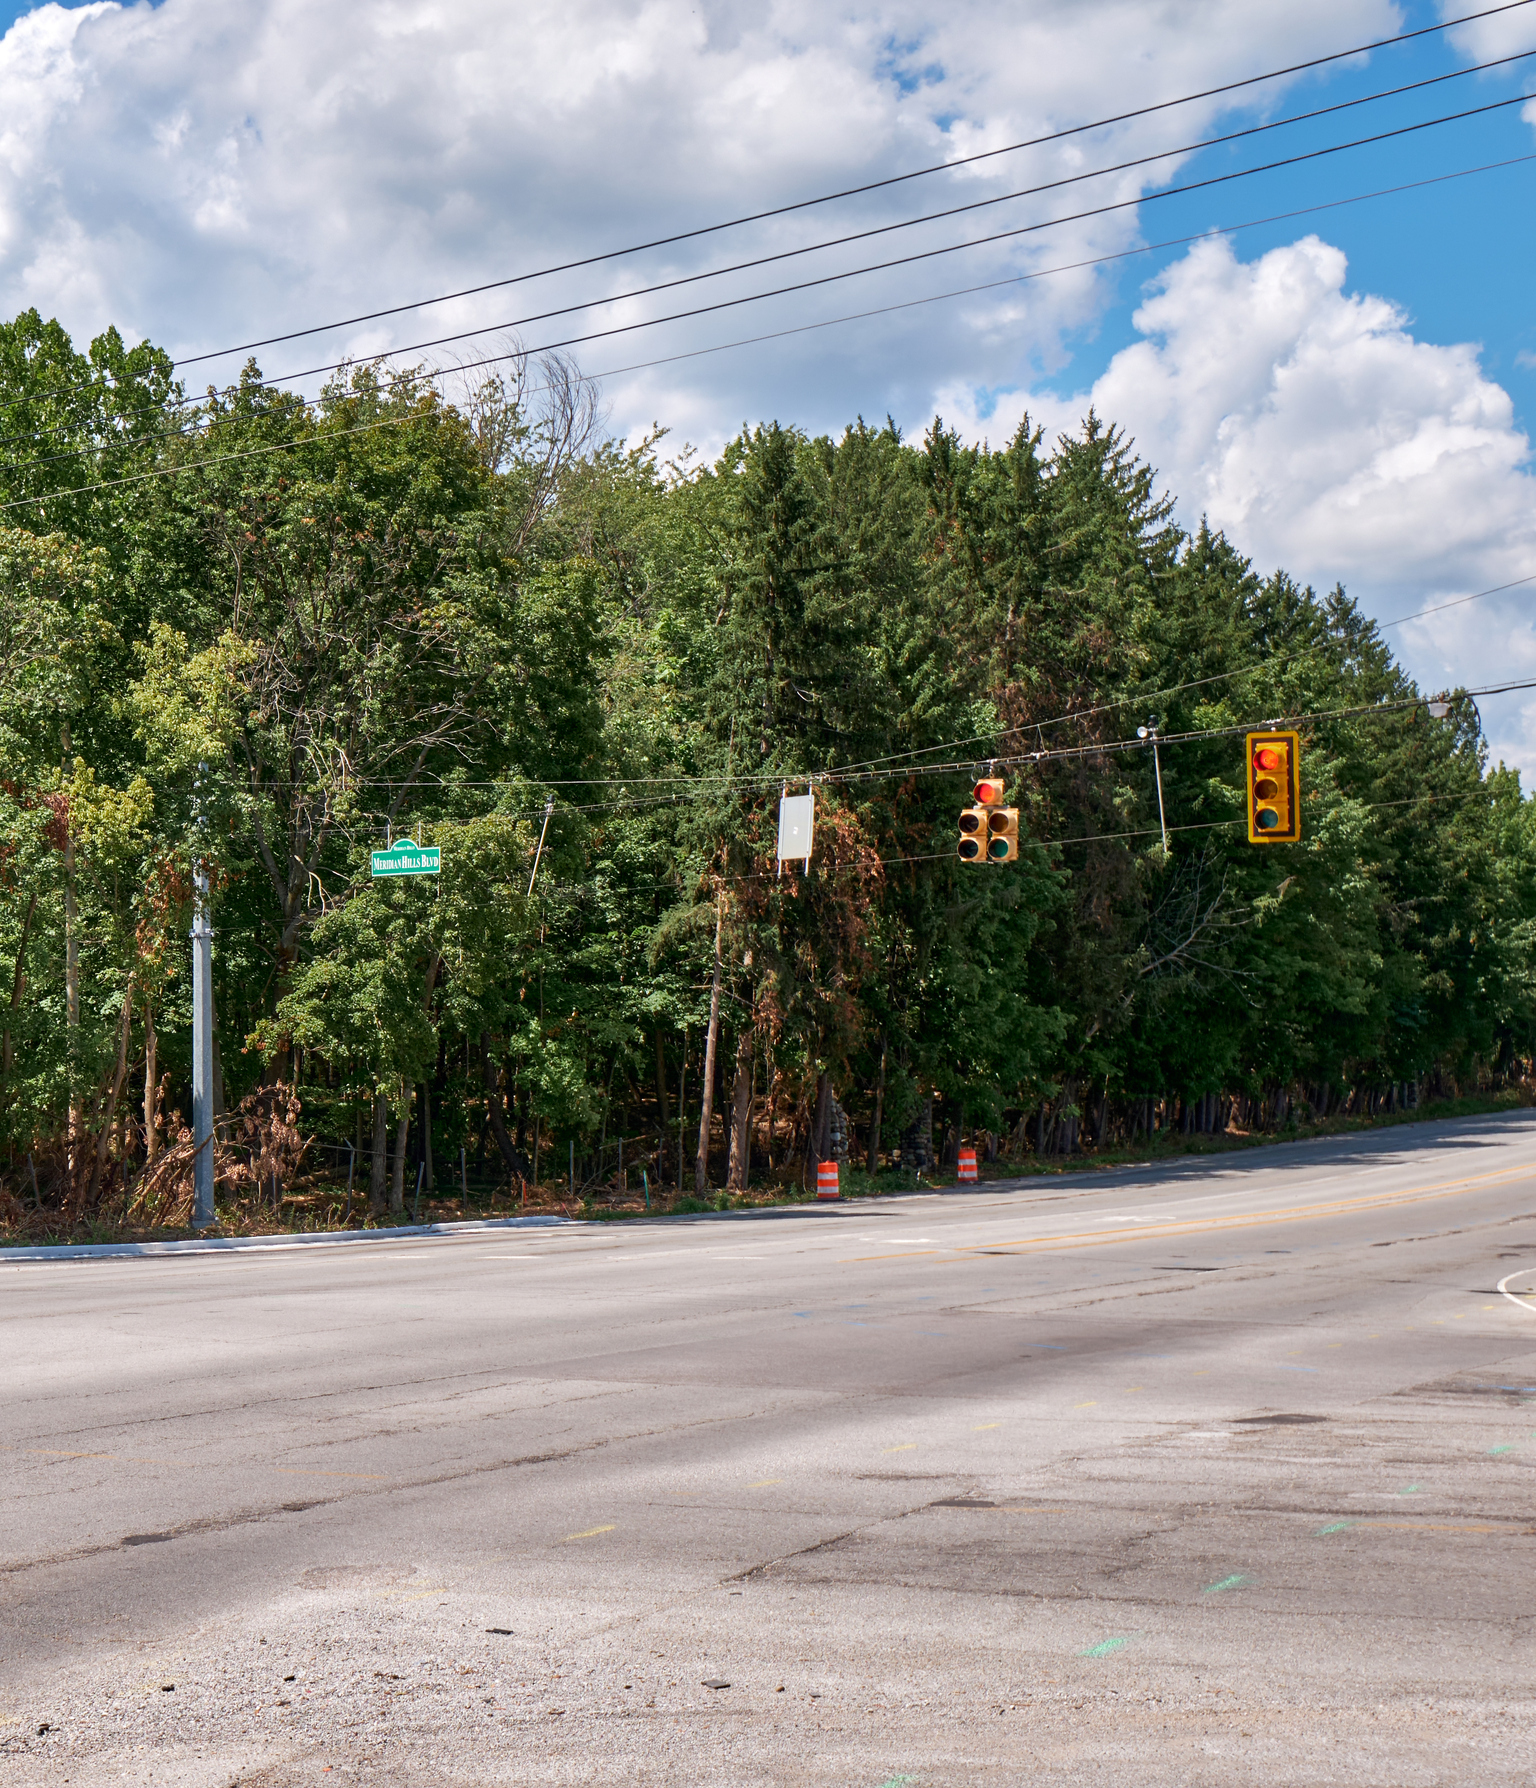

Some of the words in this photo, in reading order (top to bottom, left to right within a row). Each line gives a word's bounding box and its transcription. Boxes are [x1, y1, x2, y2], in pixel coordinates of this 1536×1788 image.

[374, 858, 402, 870] MERIDIAN
[402, 856, 420, 868] HILLS
[421, 854, 439, 868] BLVD
